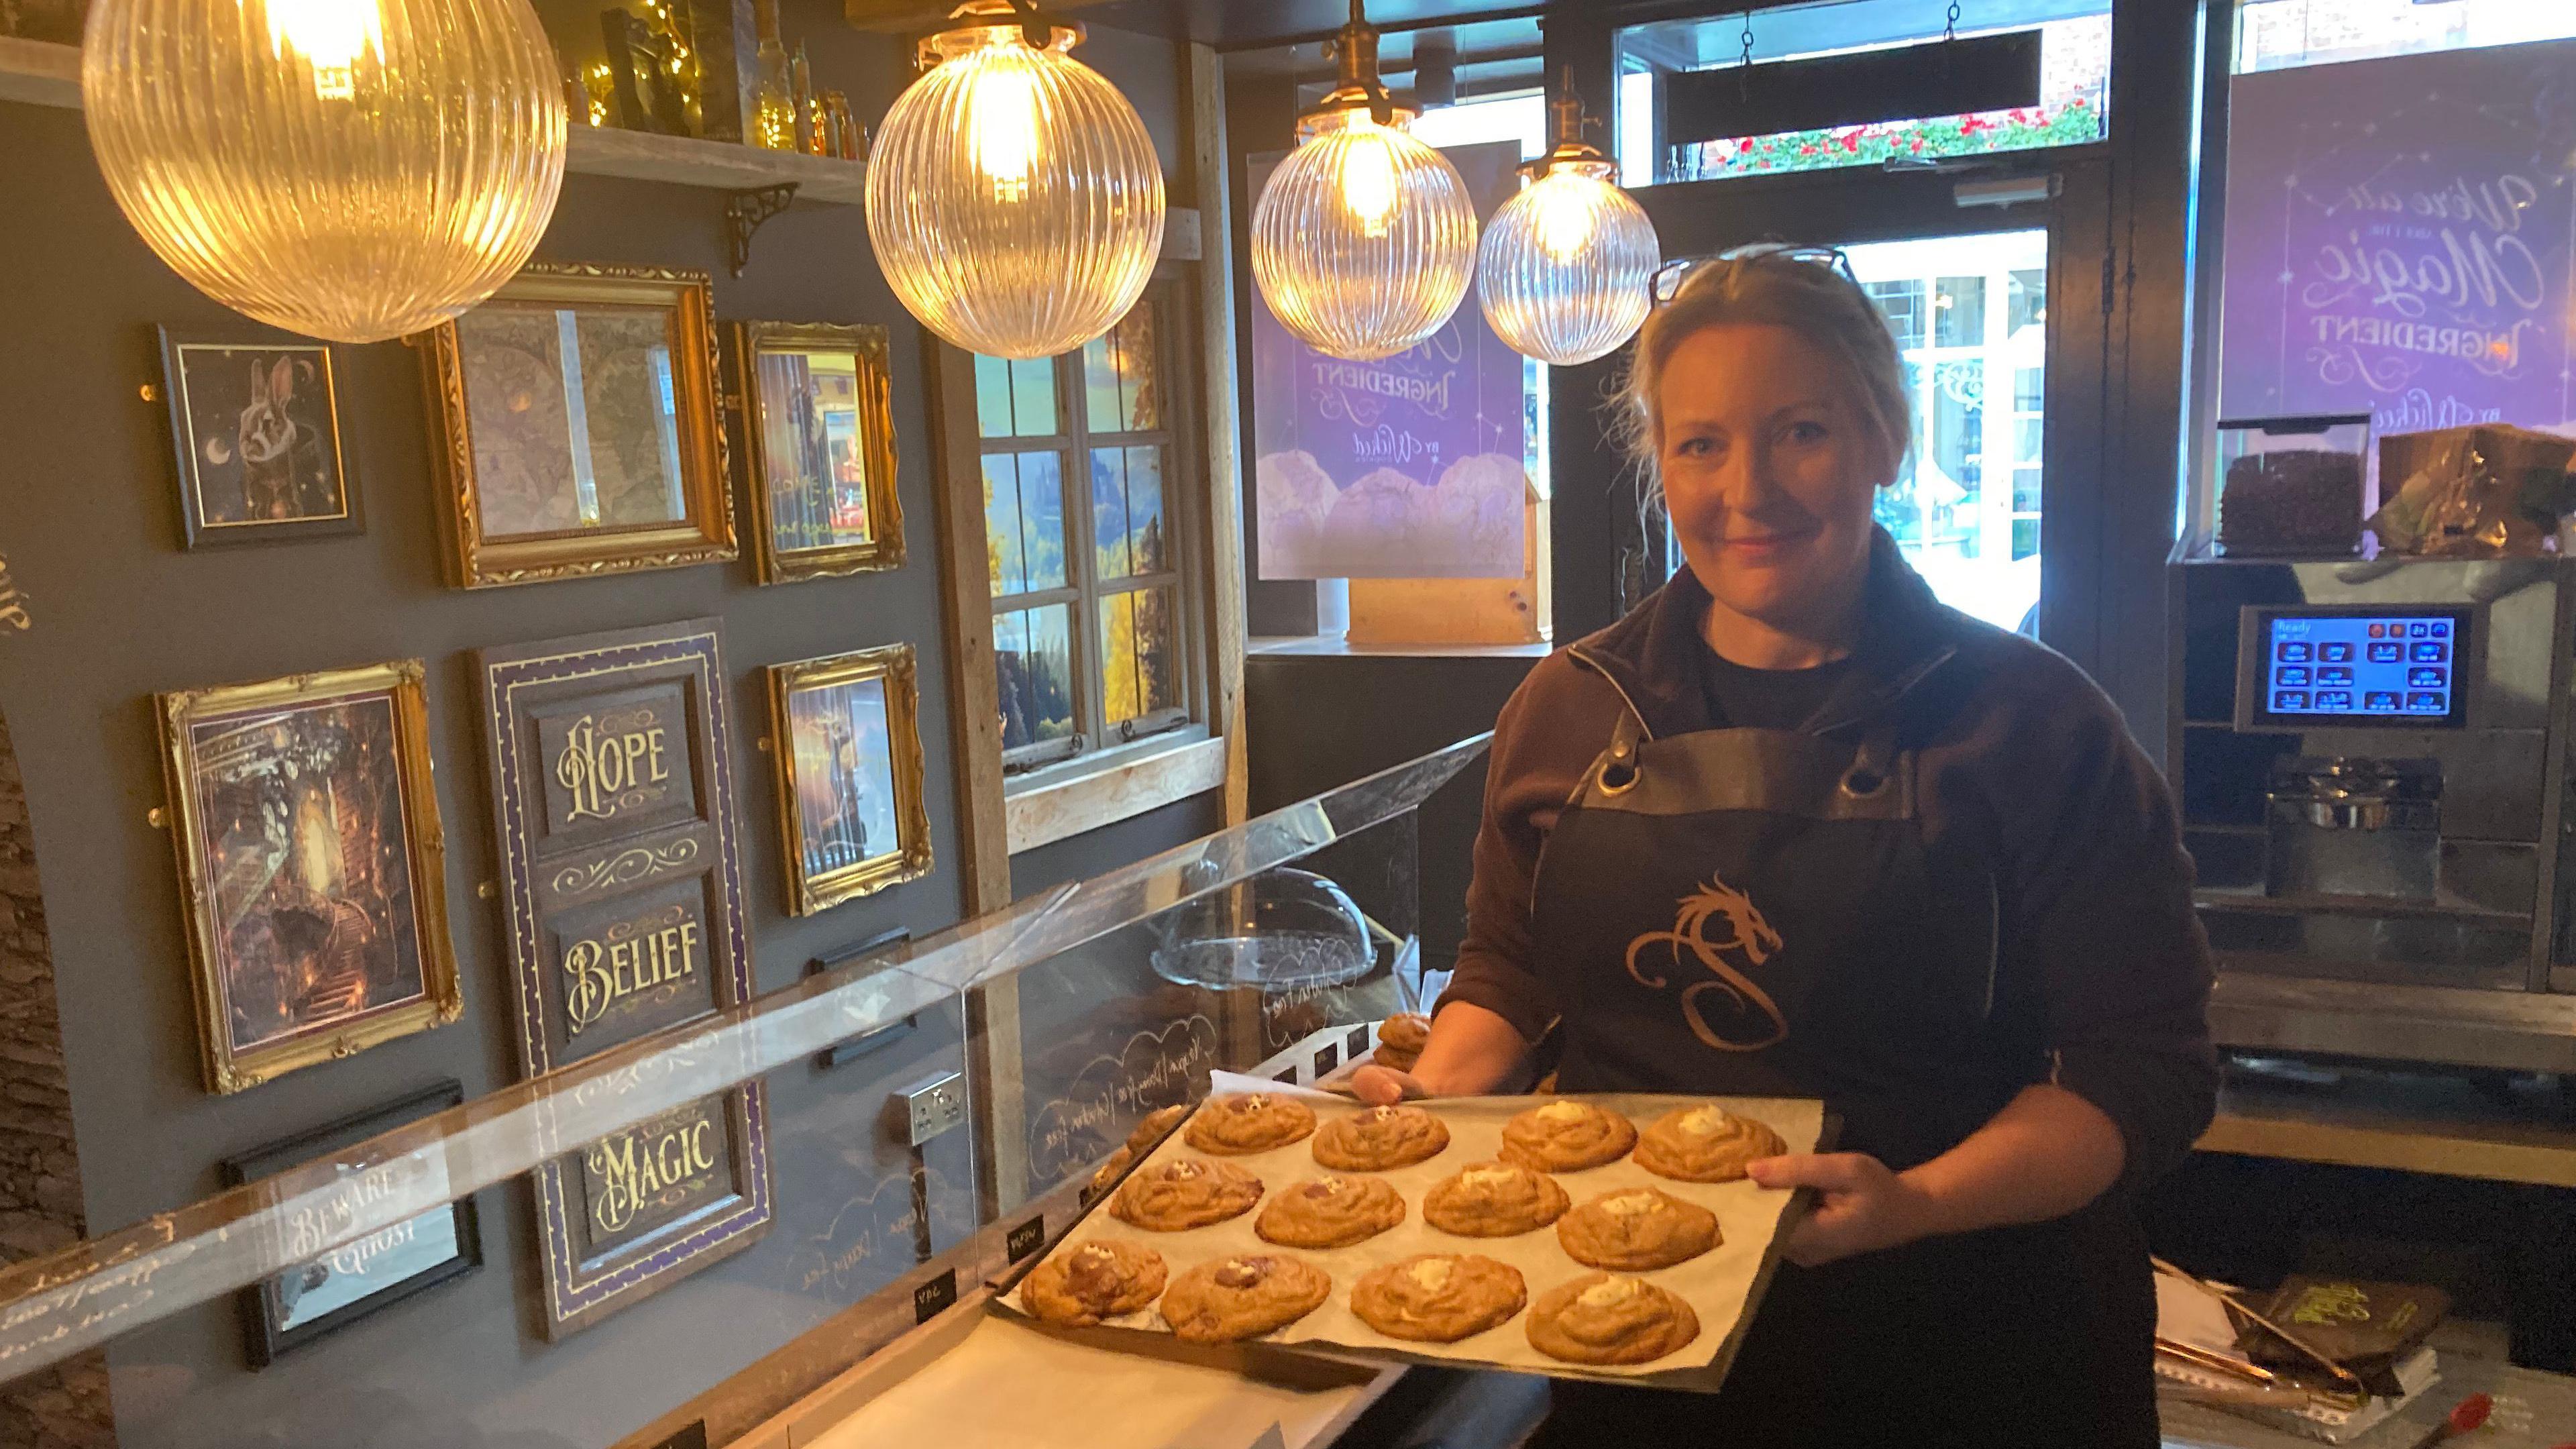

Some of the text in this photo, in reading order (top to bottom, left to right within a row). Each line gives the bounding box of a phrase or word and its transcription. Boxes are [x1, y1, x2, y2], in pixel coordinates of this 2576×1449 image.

[557, 715, 668, 822] HOPE
[564, 922, 697, 1034] BELIEF
[588, 1120, 714, 1232] MAGIC
